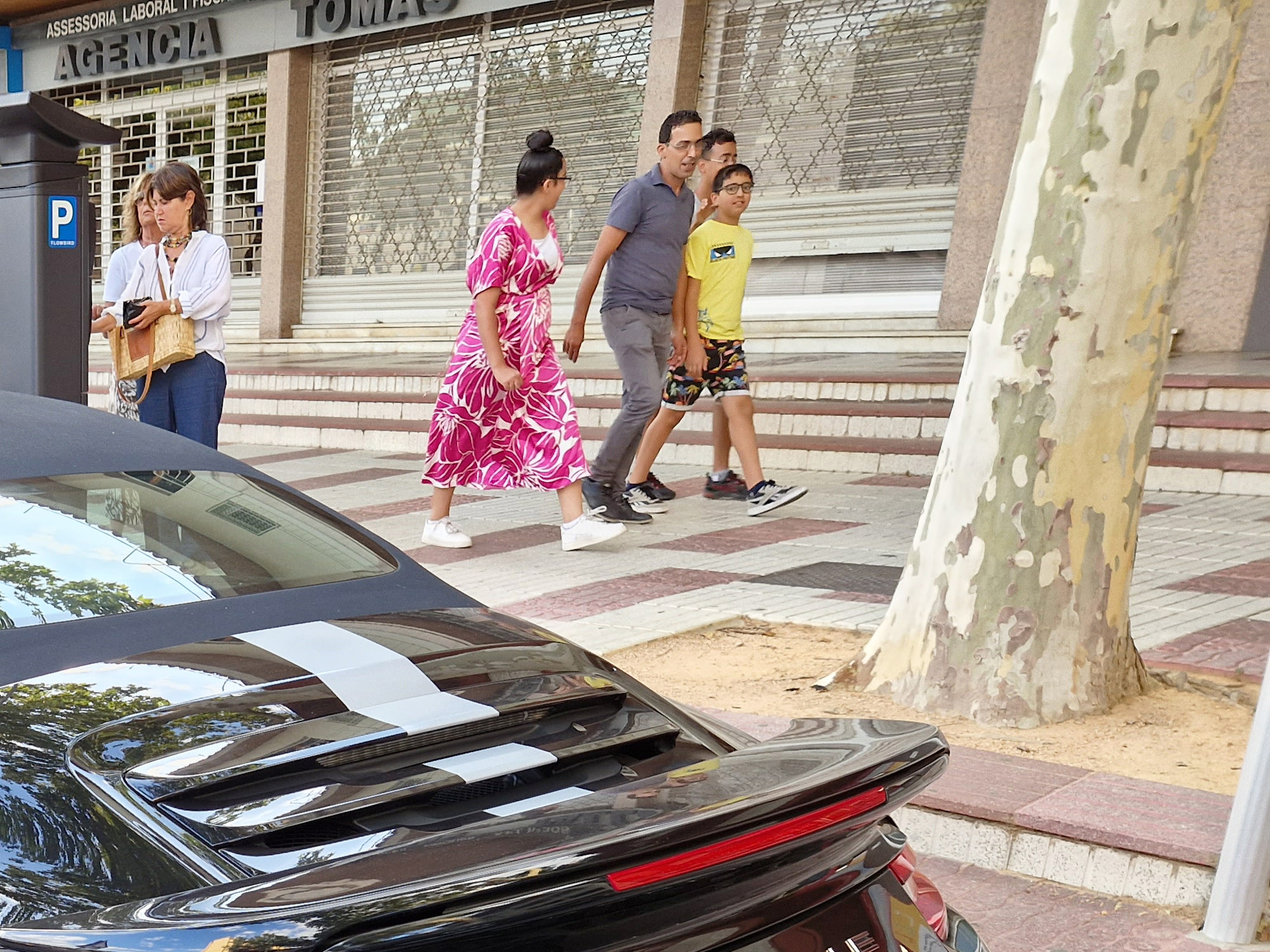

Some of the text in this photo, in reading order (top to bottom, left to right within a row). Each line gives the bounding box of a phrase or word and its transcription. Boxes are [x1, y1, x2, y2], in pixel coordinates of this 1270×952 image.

[47, 15, 117, 39] ASSESSORIA
[123, 0, 178, 22] LABORAL
[54, 17, 220, 81] AGENCIA
[52, 200, 74, 239] P
